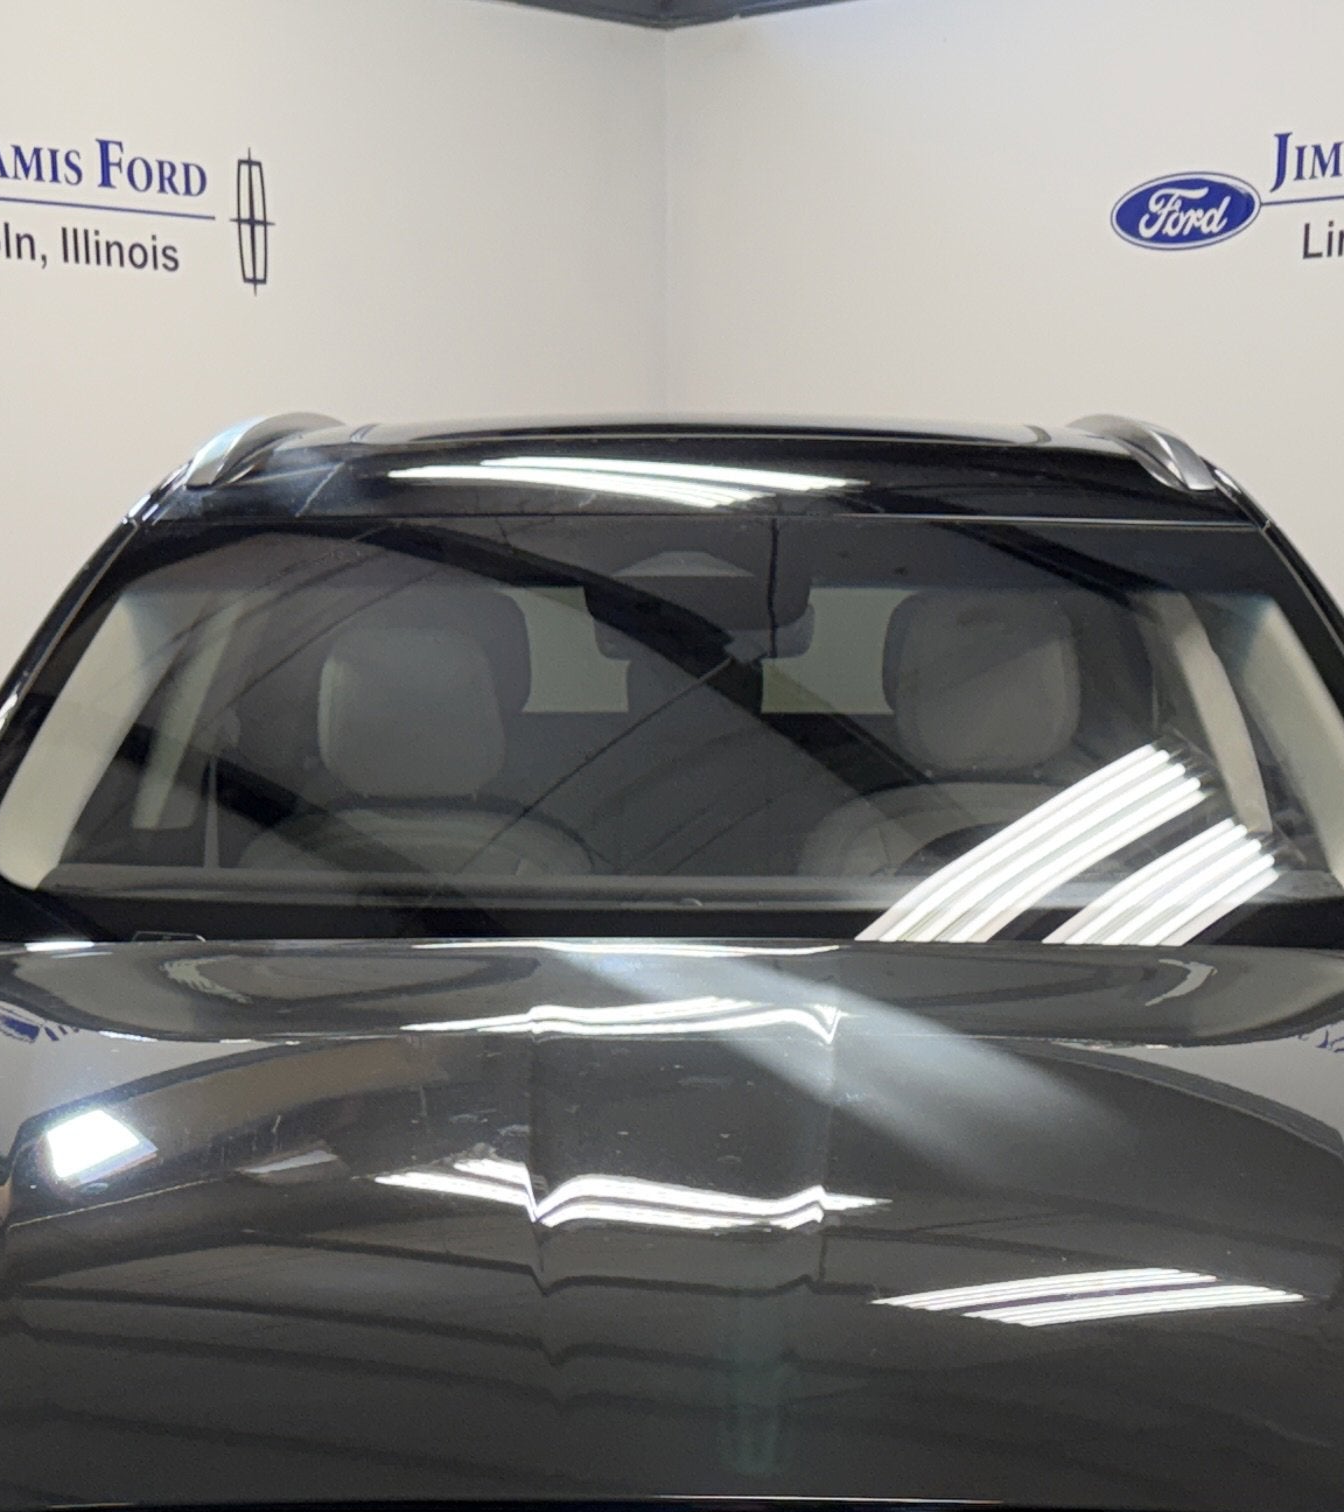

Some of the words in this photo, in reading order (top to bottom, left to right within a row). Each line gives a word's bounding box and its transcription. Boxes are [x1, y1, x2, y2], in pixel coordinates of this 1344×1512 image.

[95, 138, 208, 198] FORD
[1271, 131, 1343, 193] JIM
[1139, 186, 1228, 240] Ford
[60, 226, 180, 272] Illinois
